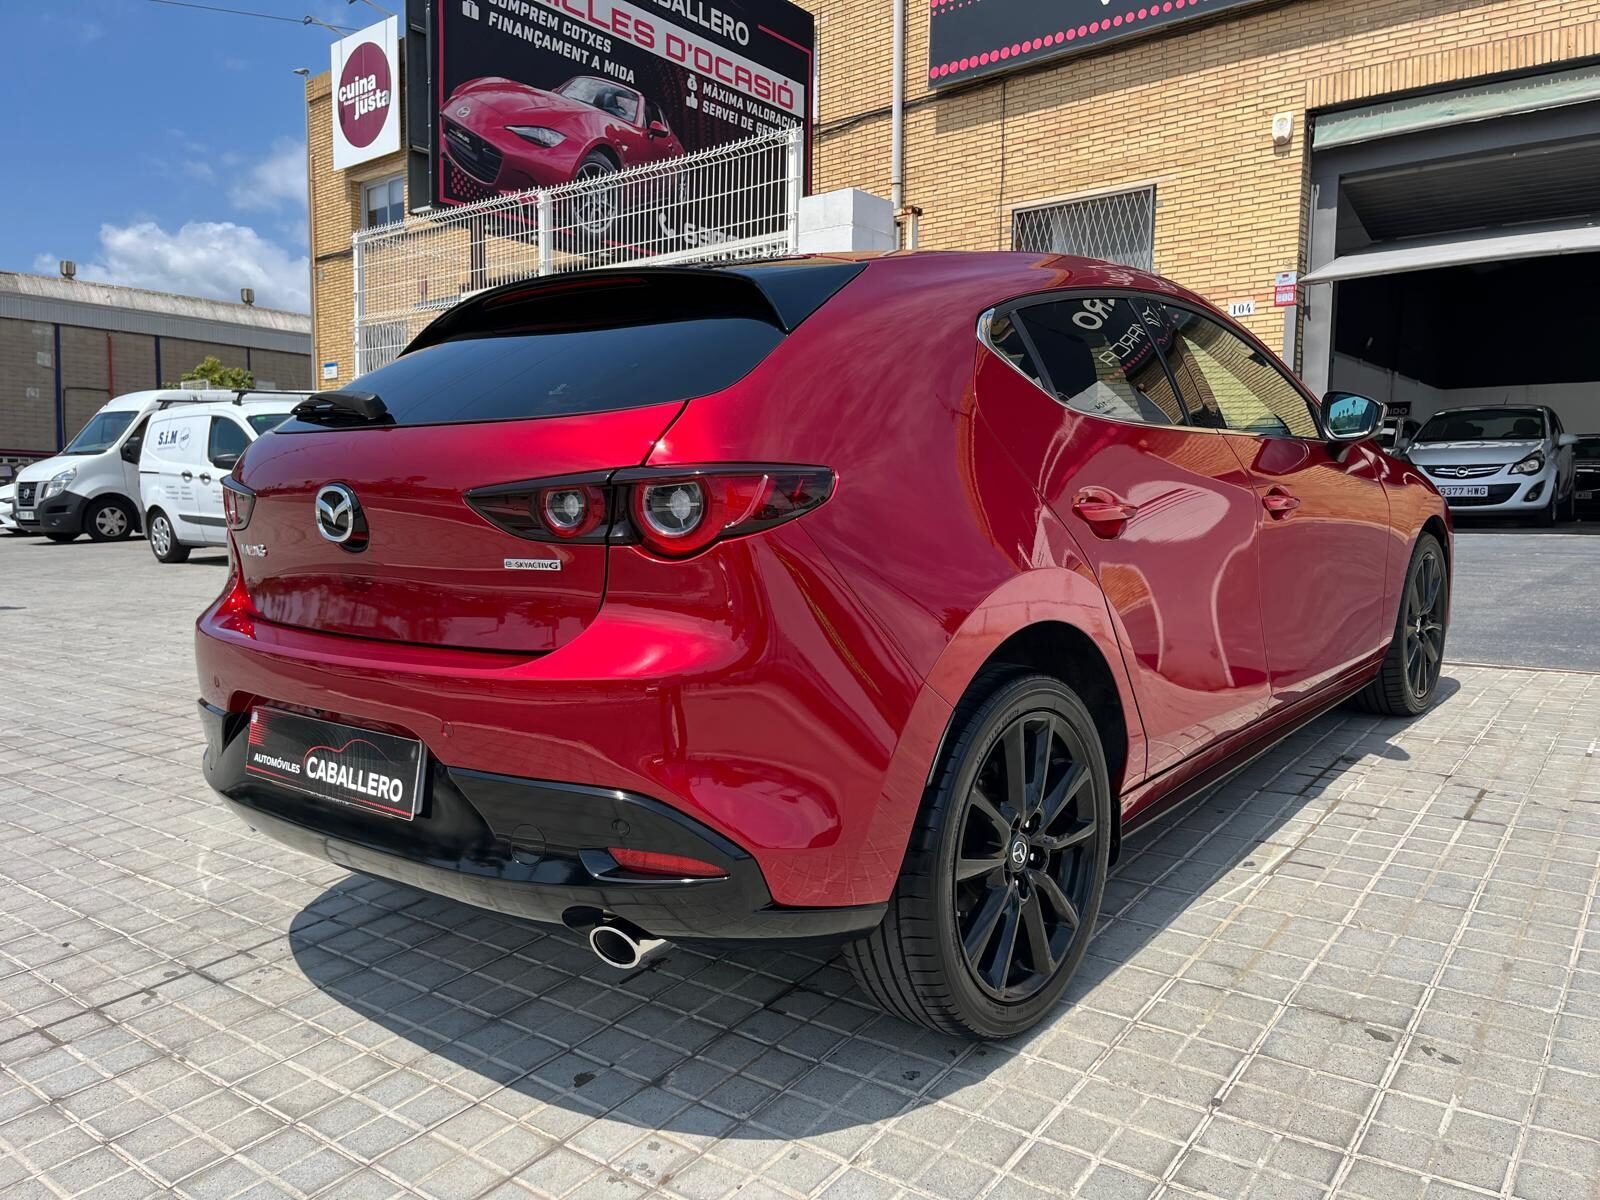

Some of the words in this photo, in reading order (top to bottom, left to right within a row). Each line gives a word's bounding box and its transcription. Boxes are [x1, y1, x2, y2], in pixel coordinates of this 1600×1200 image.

[562, 21, 612, 54] COTXES
[652, 0, 749, 46] ALLERO
[488, 11, 590, 65] FINANÇAMENT
[591, 55, 600, 70] A
[604, 59, 635, 84] MIDA
[665, 32, 794, 110] D'OCASIÓ
[339, 74, 376, 102] cuina
[354, 88, 390, 120] justa
[703, 82, 743, 110] MÀXIMA
[702, 101, 738, 125] SERVEI
[740, 114, 753, 131] DE
[1232, 303, 1251, 315] 104
[1440, 486, 1464, 496] 9377
[1467, 486, 1486, 496] HWG
[253, 752, 301, 775] AUTOMÓVILES
[306, 756, 403, 802] CABALLERO
